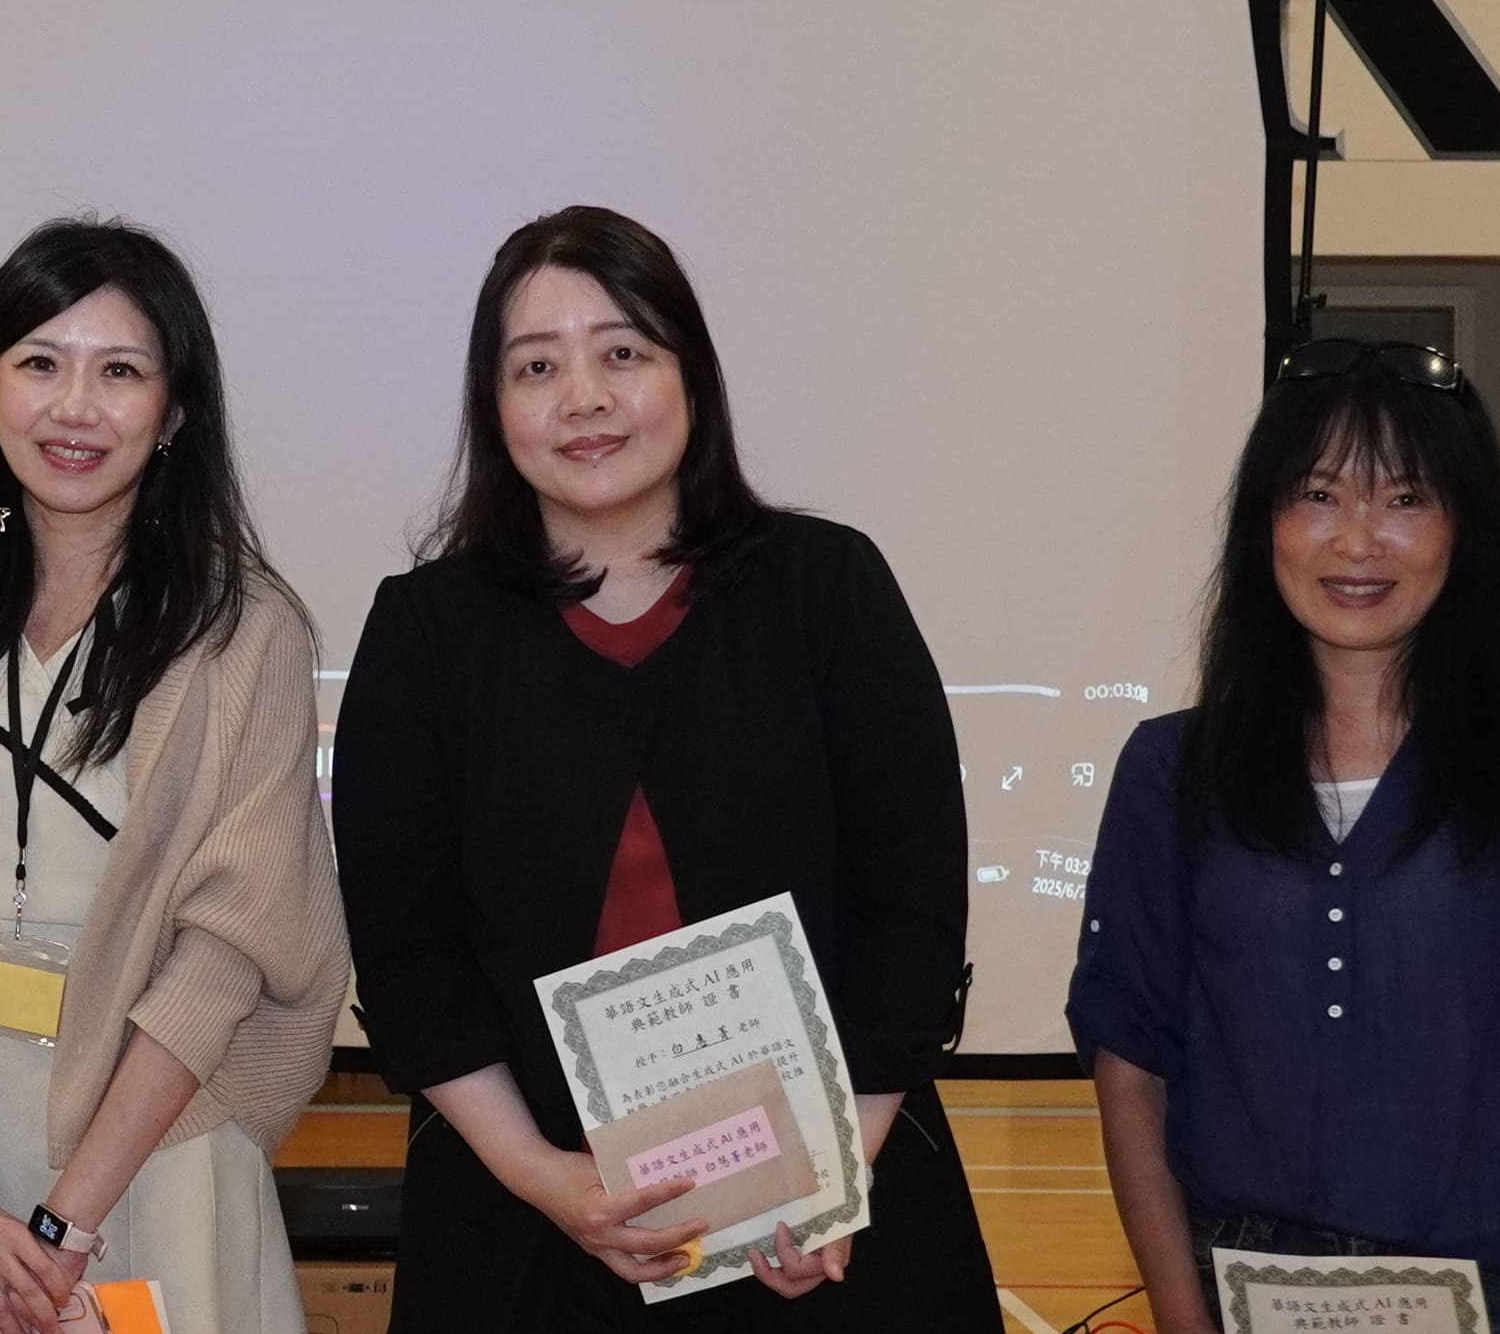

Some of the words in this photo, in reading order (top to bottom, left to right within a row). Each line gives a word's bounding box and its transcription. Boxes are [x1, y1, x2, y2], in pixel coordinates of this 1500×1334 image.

[1036, 850, 1063, 870] 下午
[1065, 857, 1093, 875] 03:2
[605, 978, 701, 1021] 華語文生成式
[704, 970, 720, 986] AI
[724, 958, 756, 980] 應用
[631, 1001, 694, 1034] 典範教師
[639, 1138, 720, 1176] 華語文生成式
[721, 1133, 733, 1146] AI
[735, 1121, 762, 1140] 應用
[1374, 1297, 1391, 1309] AI
